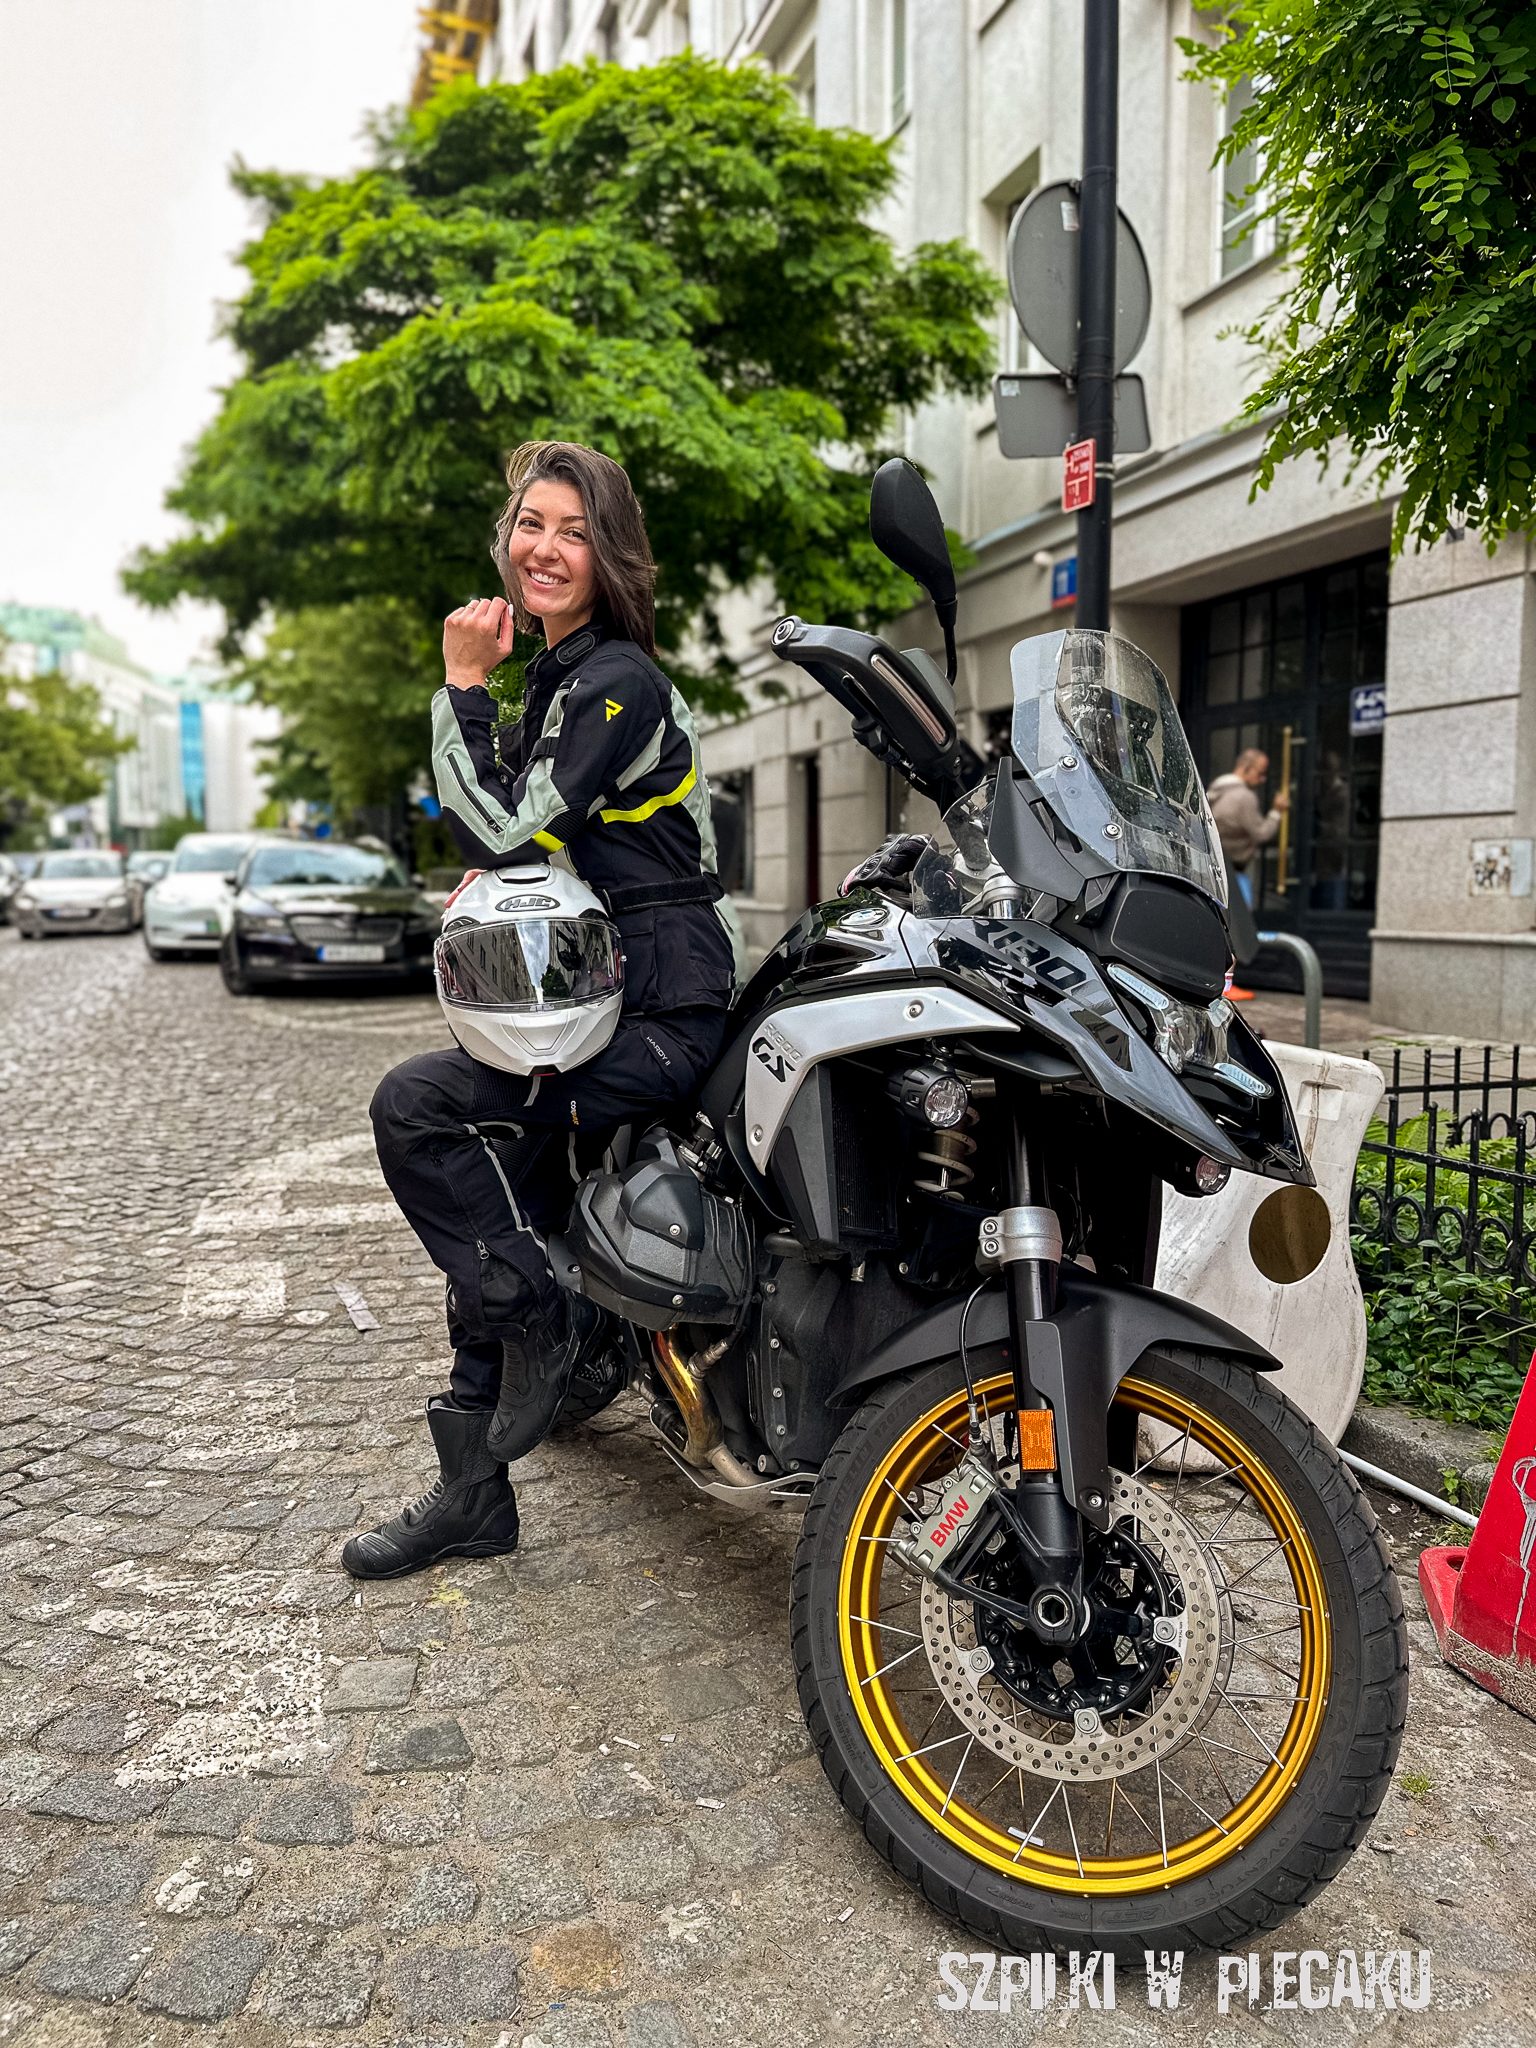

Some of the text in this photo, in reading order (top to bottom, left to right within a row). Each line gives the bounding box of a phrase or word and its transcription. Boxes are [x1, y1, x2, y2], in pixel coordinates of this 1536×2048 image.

[504, 897, 552, 910] HJC
[646, 1036, 668, 1060] HARDY
[752, 1036, 796, 1083] GS
[929, 1494, 970, 1549] BMW
[1192, 1823, 1299, 1908] ADVENTURE
